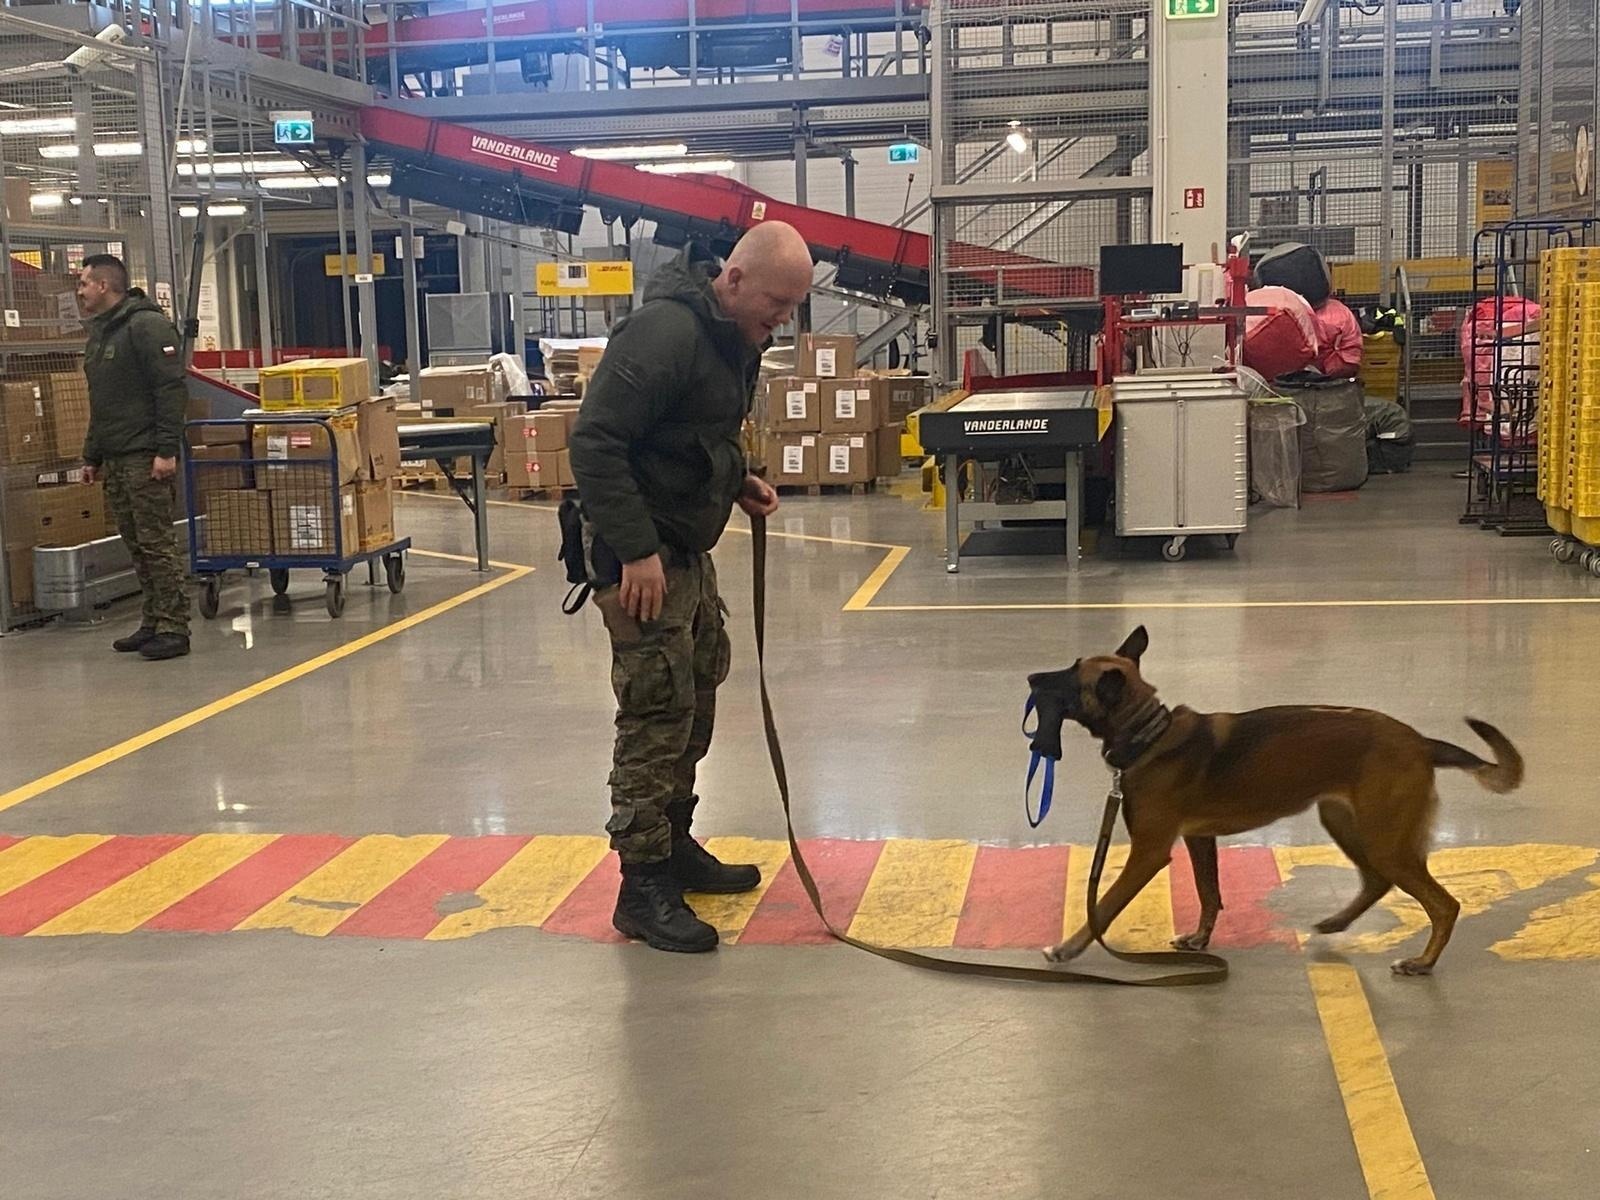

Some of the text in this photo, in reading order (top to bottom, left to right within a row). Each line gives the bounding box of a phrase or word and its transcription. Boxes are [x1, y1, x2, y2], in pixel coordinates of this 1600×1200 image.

[481, 10, 526, 25] VDERLANDE
[471, 135, 560, 169] VANDERLANDE
[964, 419, 1049, 431] VANDERLANDE
